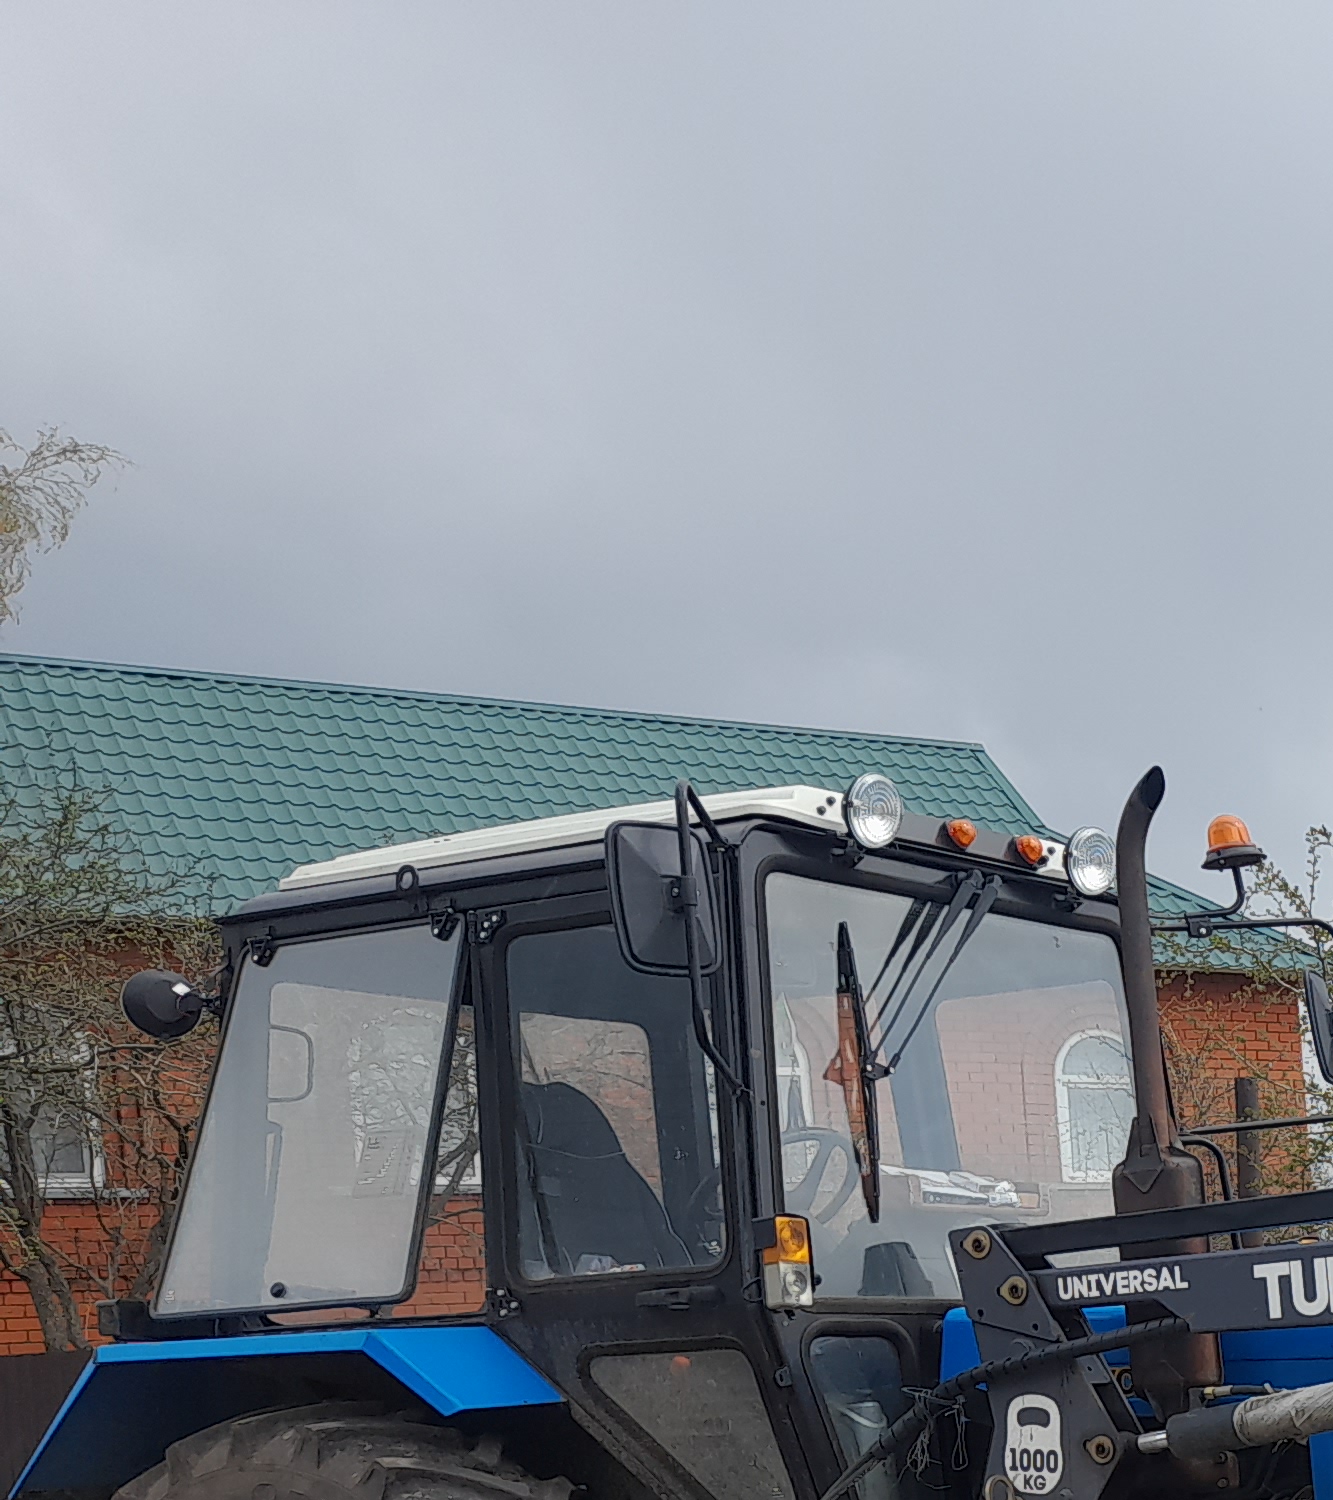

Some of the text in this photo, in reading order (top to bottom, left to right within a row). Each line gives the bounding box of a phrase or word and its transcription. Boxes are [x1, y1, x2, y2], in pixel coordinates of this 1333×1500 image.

[1058, 1265, 1189, 1300] UNIVERSAL
[1009, 1447, 1059, 1473] 1000
[1023, 1474, 1047, 1490] KG
